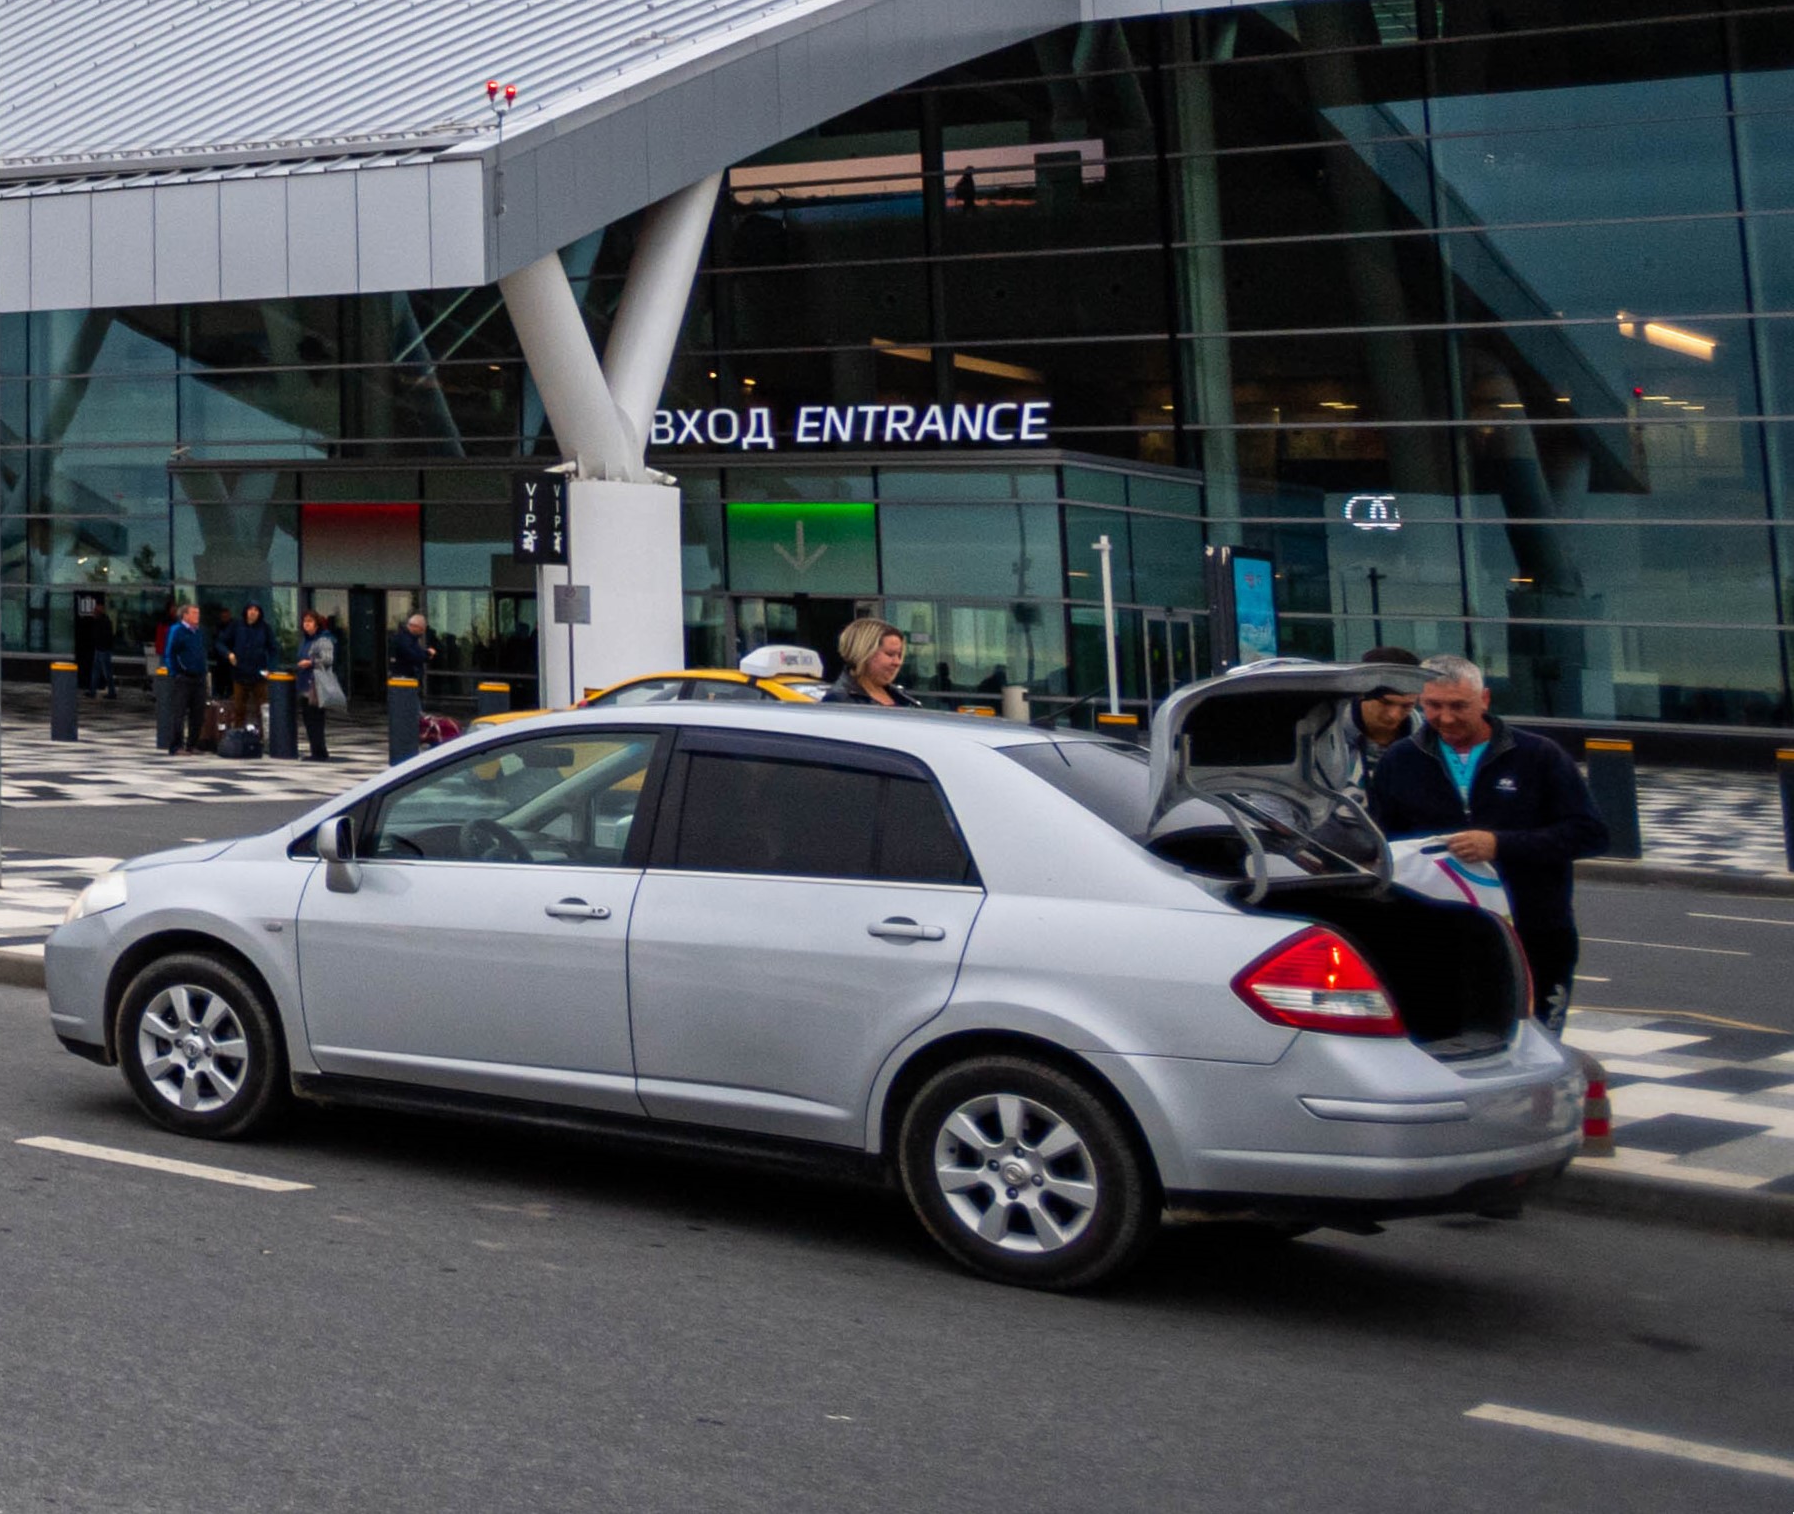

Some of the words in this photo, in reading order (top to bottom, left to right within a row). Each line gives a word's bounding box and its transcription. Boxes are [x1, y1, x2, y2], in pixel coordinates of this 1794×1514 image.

[650, 407, 775, 450] ВХОД
[796, 401, 1051, 443] ENTRANCE
[525, 482, 537, 527] VIP
